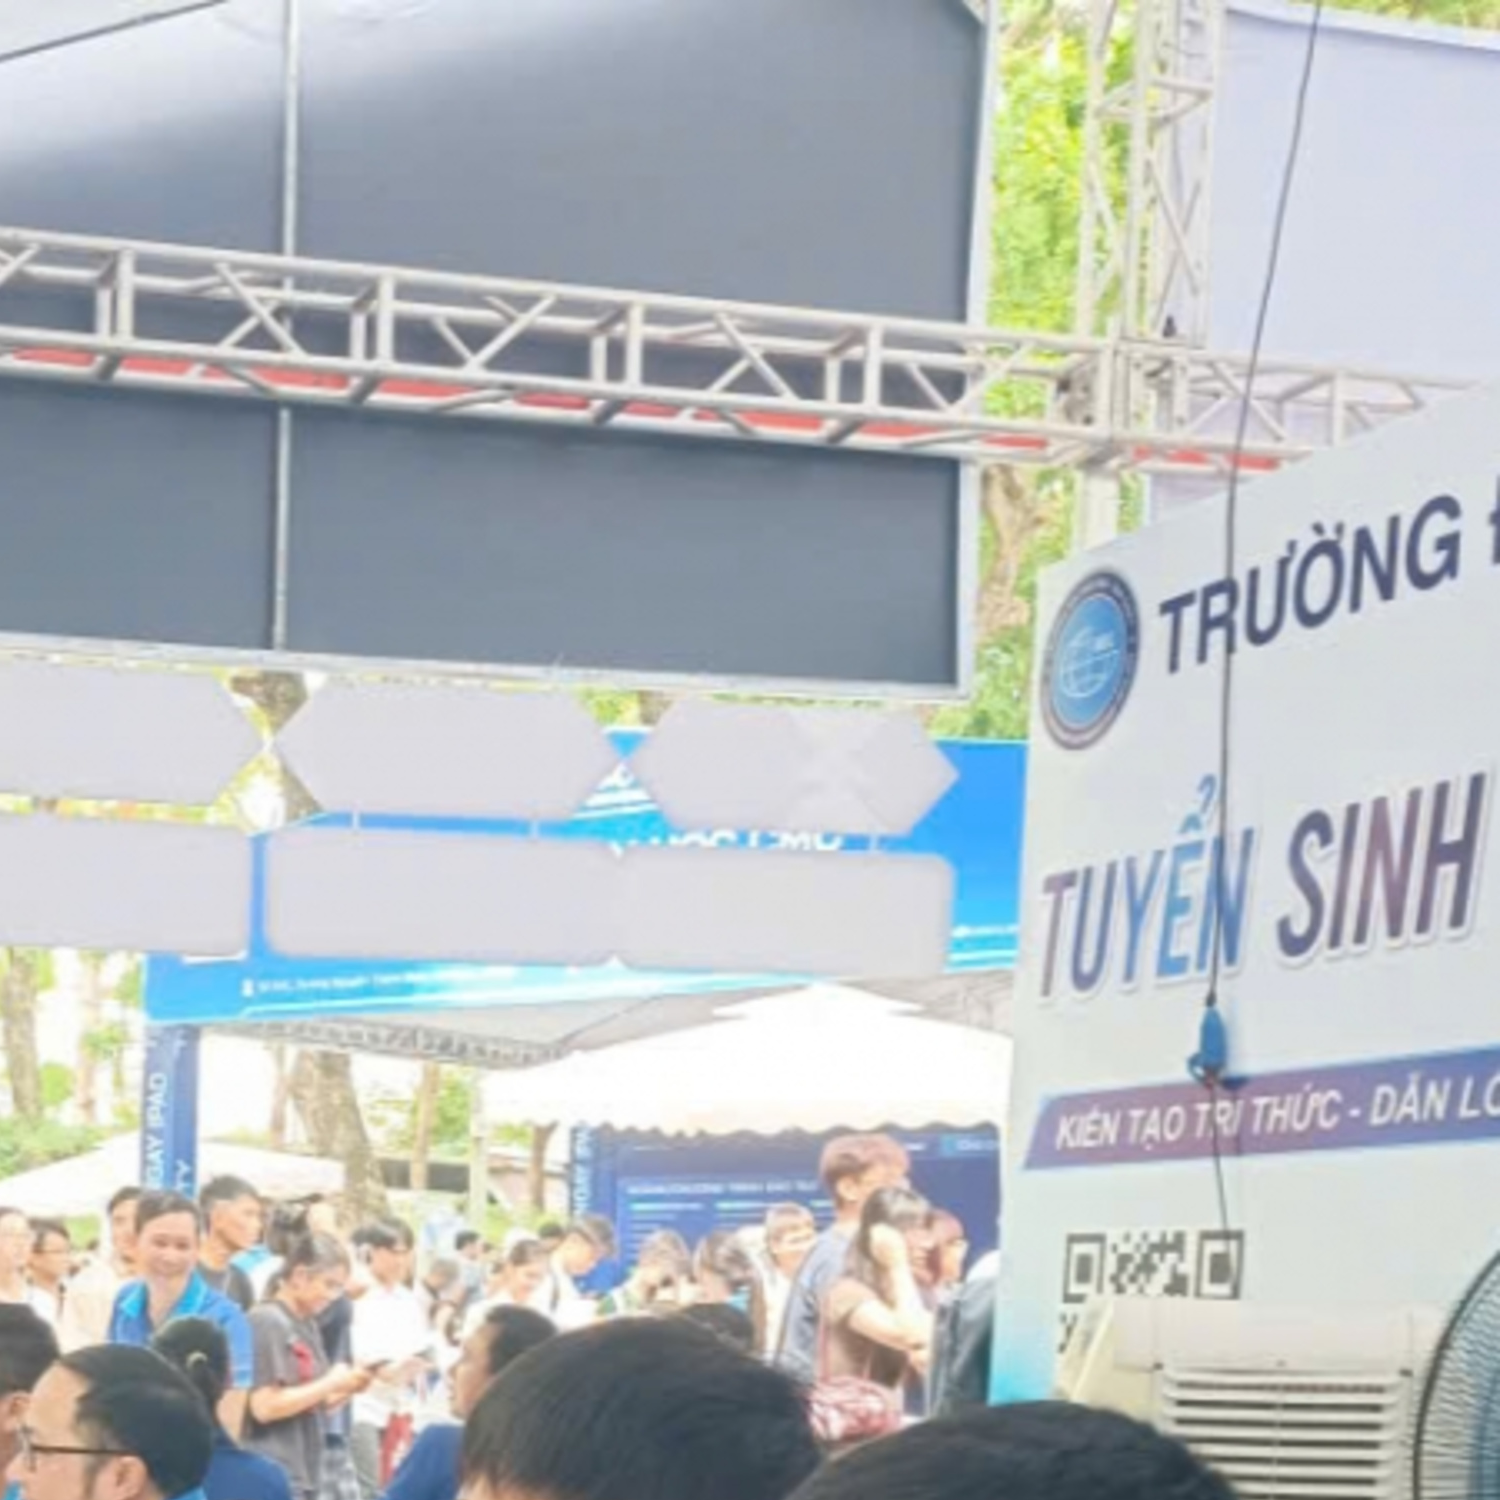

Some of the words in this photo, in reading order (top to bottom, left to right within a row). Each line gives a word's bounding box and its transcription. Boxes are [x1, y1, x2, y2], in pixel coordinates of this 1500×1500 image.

[1158, 494, 1462, 675] TRƯỜNG
[1040, 773, 1254, 998] TUYỂN
[1276, 771, 1486, 958] SINH
[1128, 1105, 1186, 1151] TẠO
[1252, 1083, 1342, 1136] THỨC
